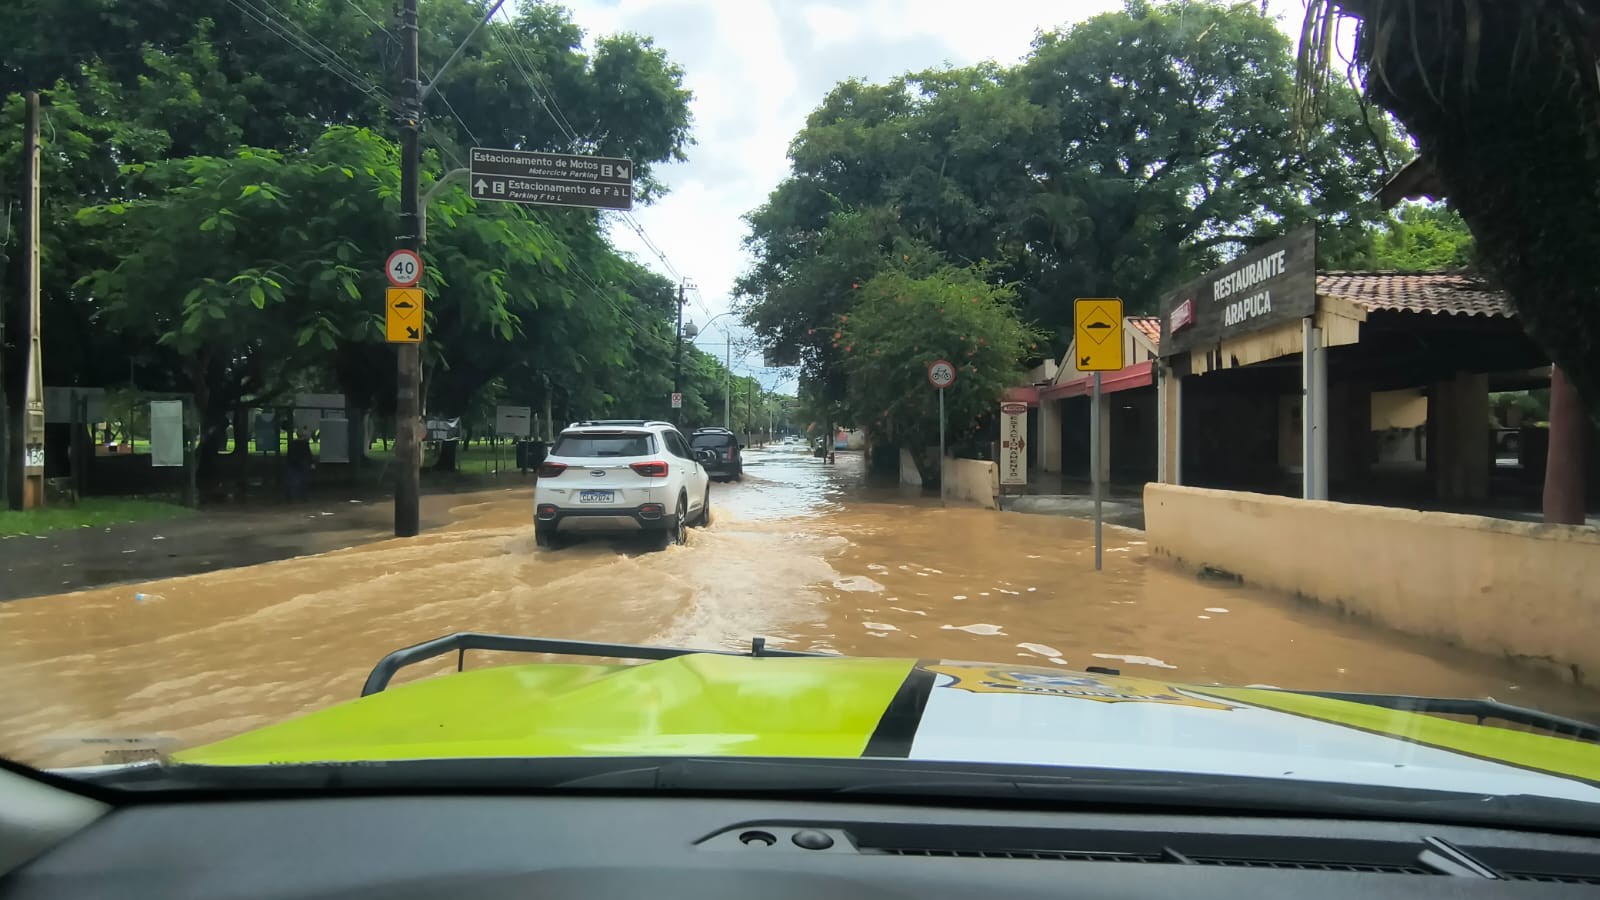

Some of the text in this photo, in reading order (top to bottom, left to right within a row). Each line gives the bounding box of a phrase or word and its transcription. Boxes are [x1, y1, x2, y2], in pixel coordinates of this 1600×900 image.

[474, 152, 552, 166] Estacionamento
[555, 159, 567, 168] de
[570, 159, 598, 170] Motos
[569, 171, 598, 180] Parking
[508, 180, 586, 194] Estacionamento
[589, 186, 601, 195] de
[604, 187, 611, 196] F
[622, 188, 629, 197] L
[509, 191, 538, 201] Parking
[394, 261, 414, 274] 40
[1213, 250, 1286, 301] RESTAURANTE
[1224, 290, 1271, 327] ARAPUCA
